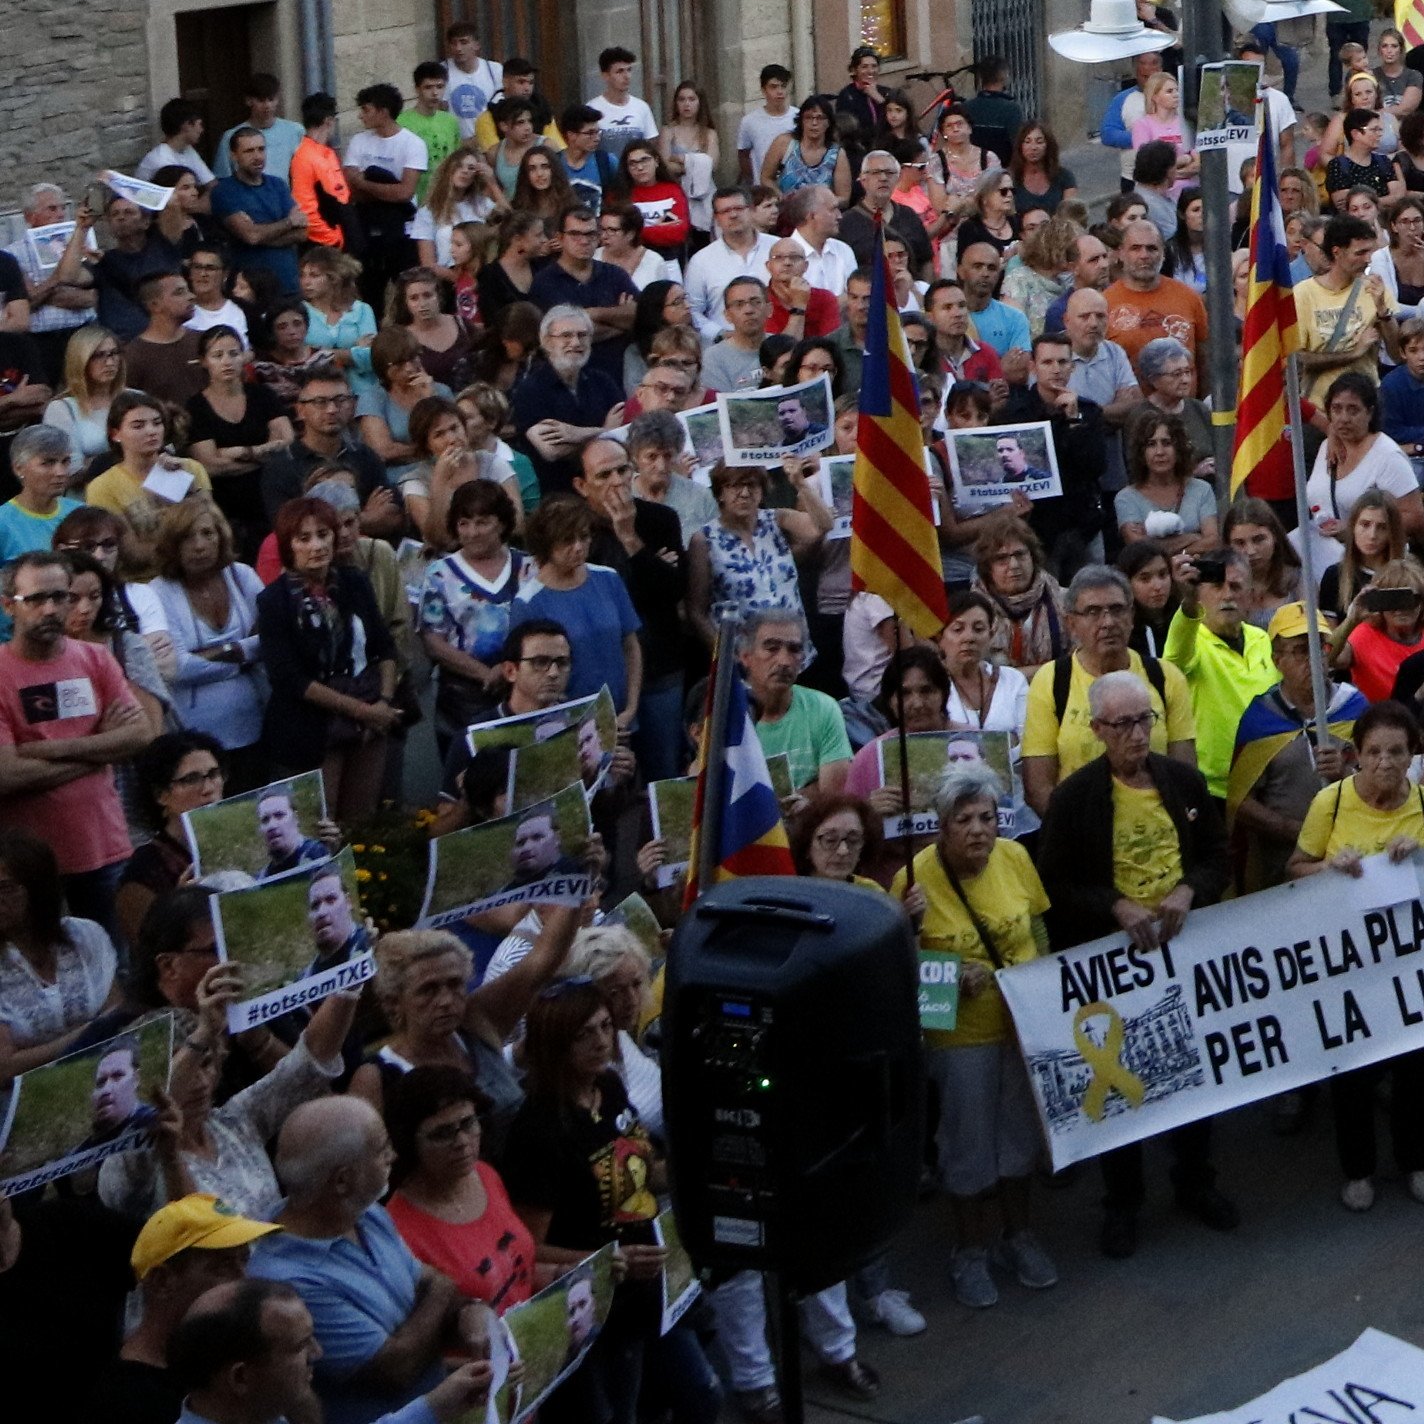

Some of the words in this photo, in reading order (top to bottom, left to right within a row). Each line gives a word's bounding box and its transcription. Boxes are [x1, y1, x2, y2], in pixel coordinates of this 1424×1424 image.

[920, 961, 957, 983] CDR
[1193, 946, 1270, 1017] AVIS
[1273, 941, 1319, 991] DE
[1319, 929, 1364, 976] LA
[1205, 1015, 1290, 1085] PER
[1313, 990, 1372, 1050] LA
